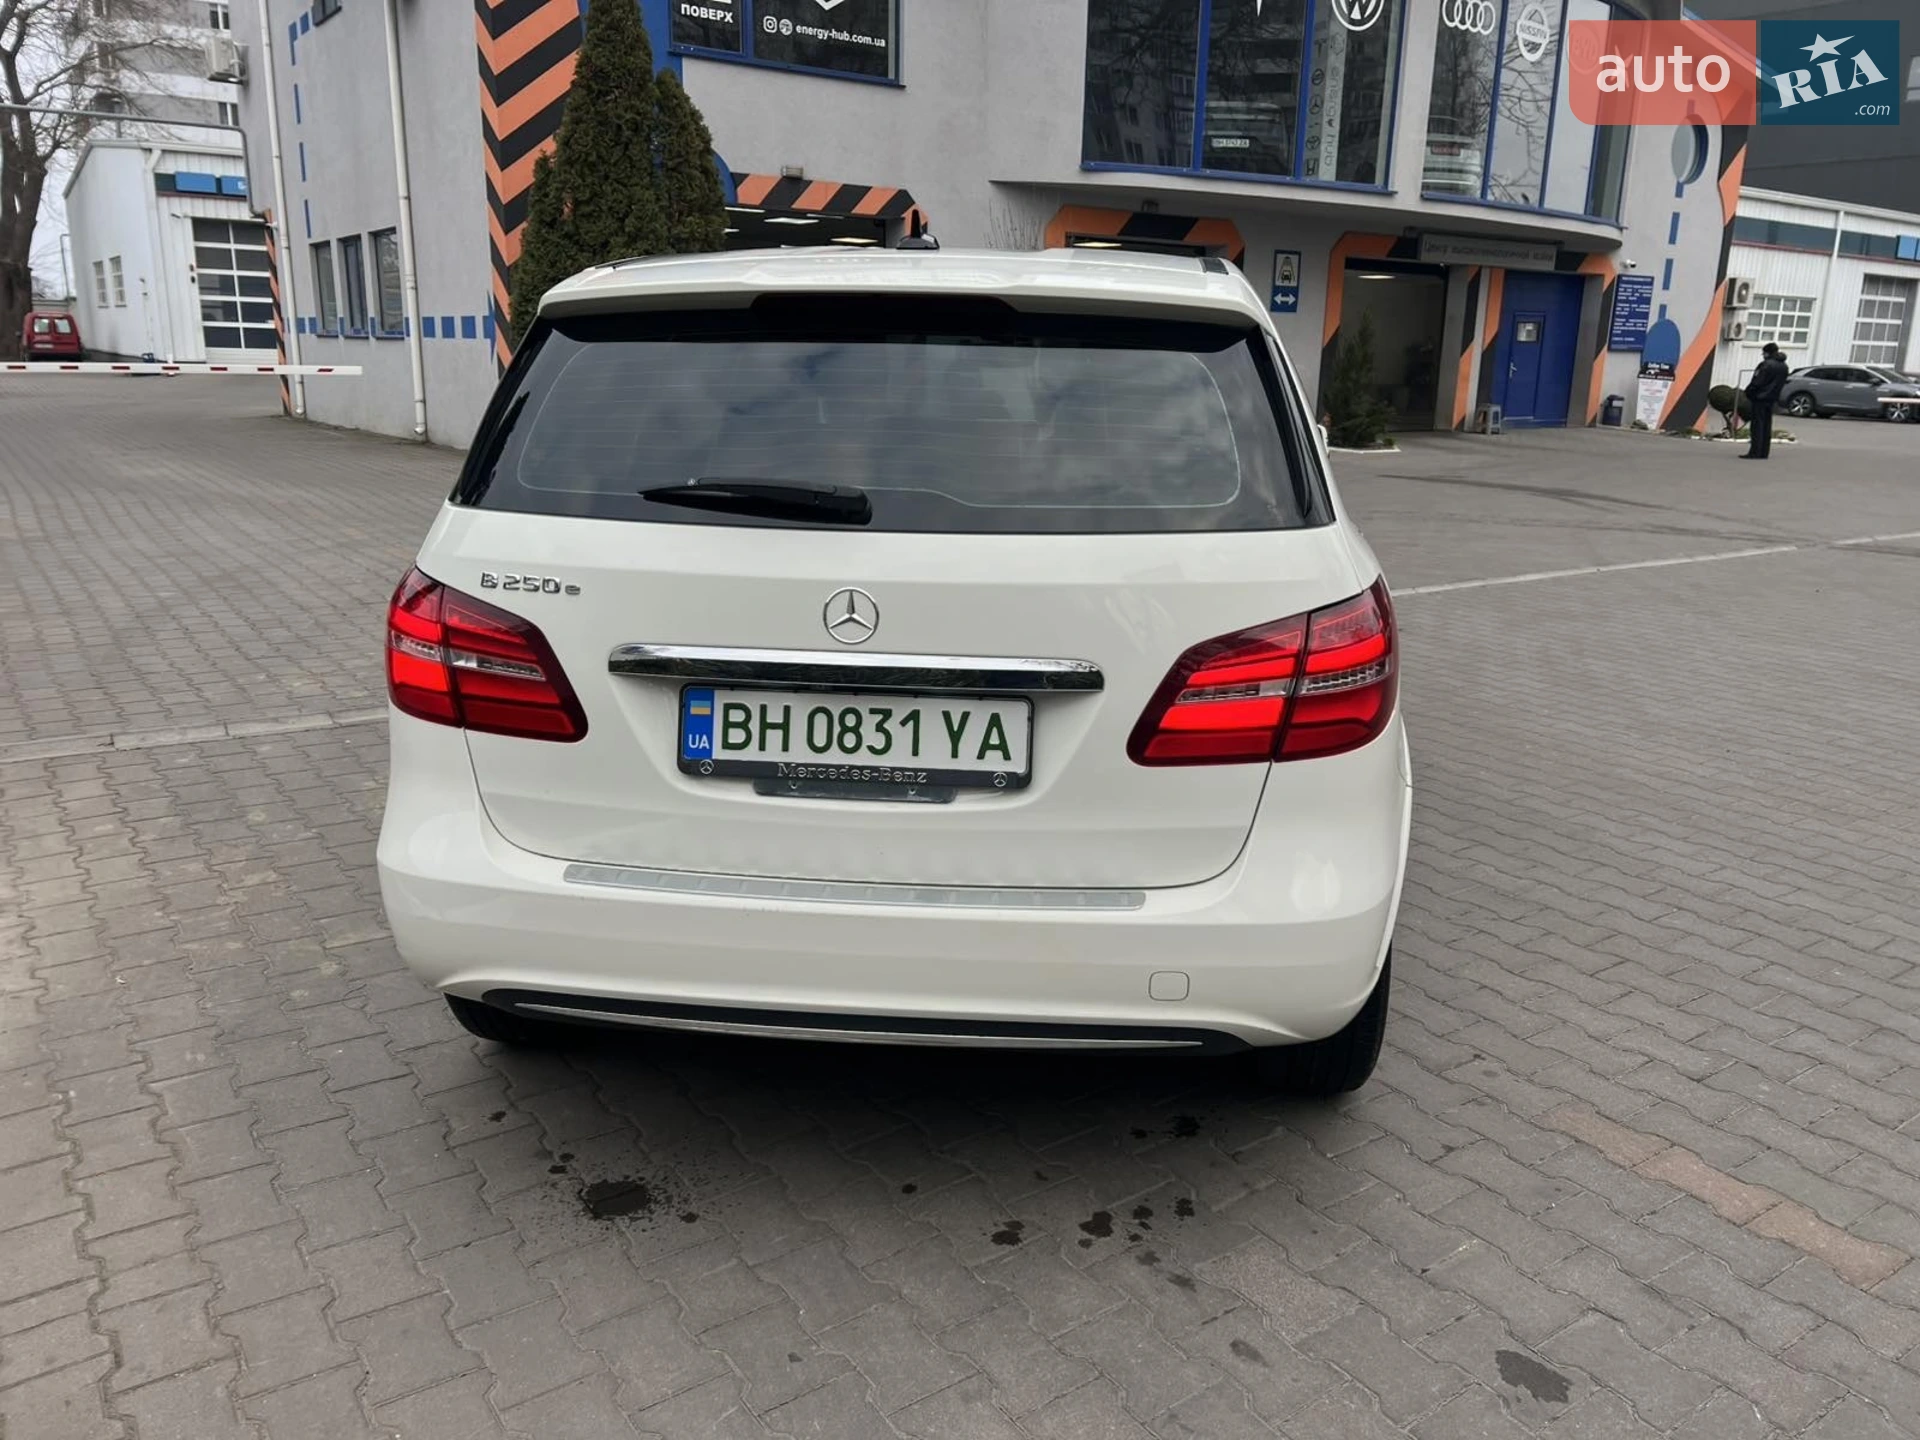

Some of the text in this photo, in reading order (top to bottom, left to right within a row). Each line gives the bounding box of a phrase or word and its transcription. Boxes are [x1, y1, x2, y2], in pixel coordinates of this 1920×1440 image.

[681, 3, 734, 24] ПОВЕРХ
[795, 24, 886, 47] energy-hub.com.ua
[480, 572, 499, 589] B
[502, 574, 561, 594] 250
[688, 702, 1012, 762] UA BH 0831 YA
[777, 762, 928, 784] Mercedes-Benz
